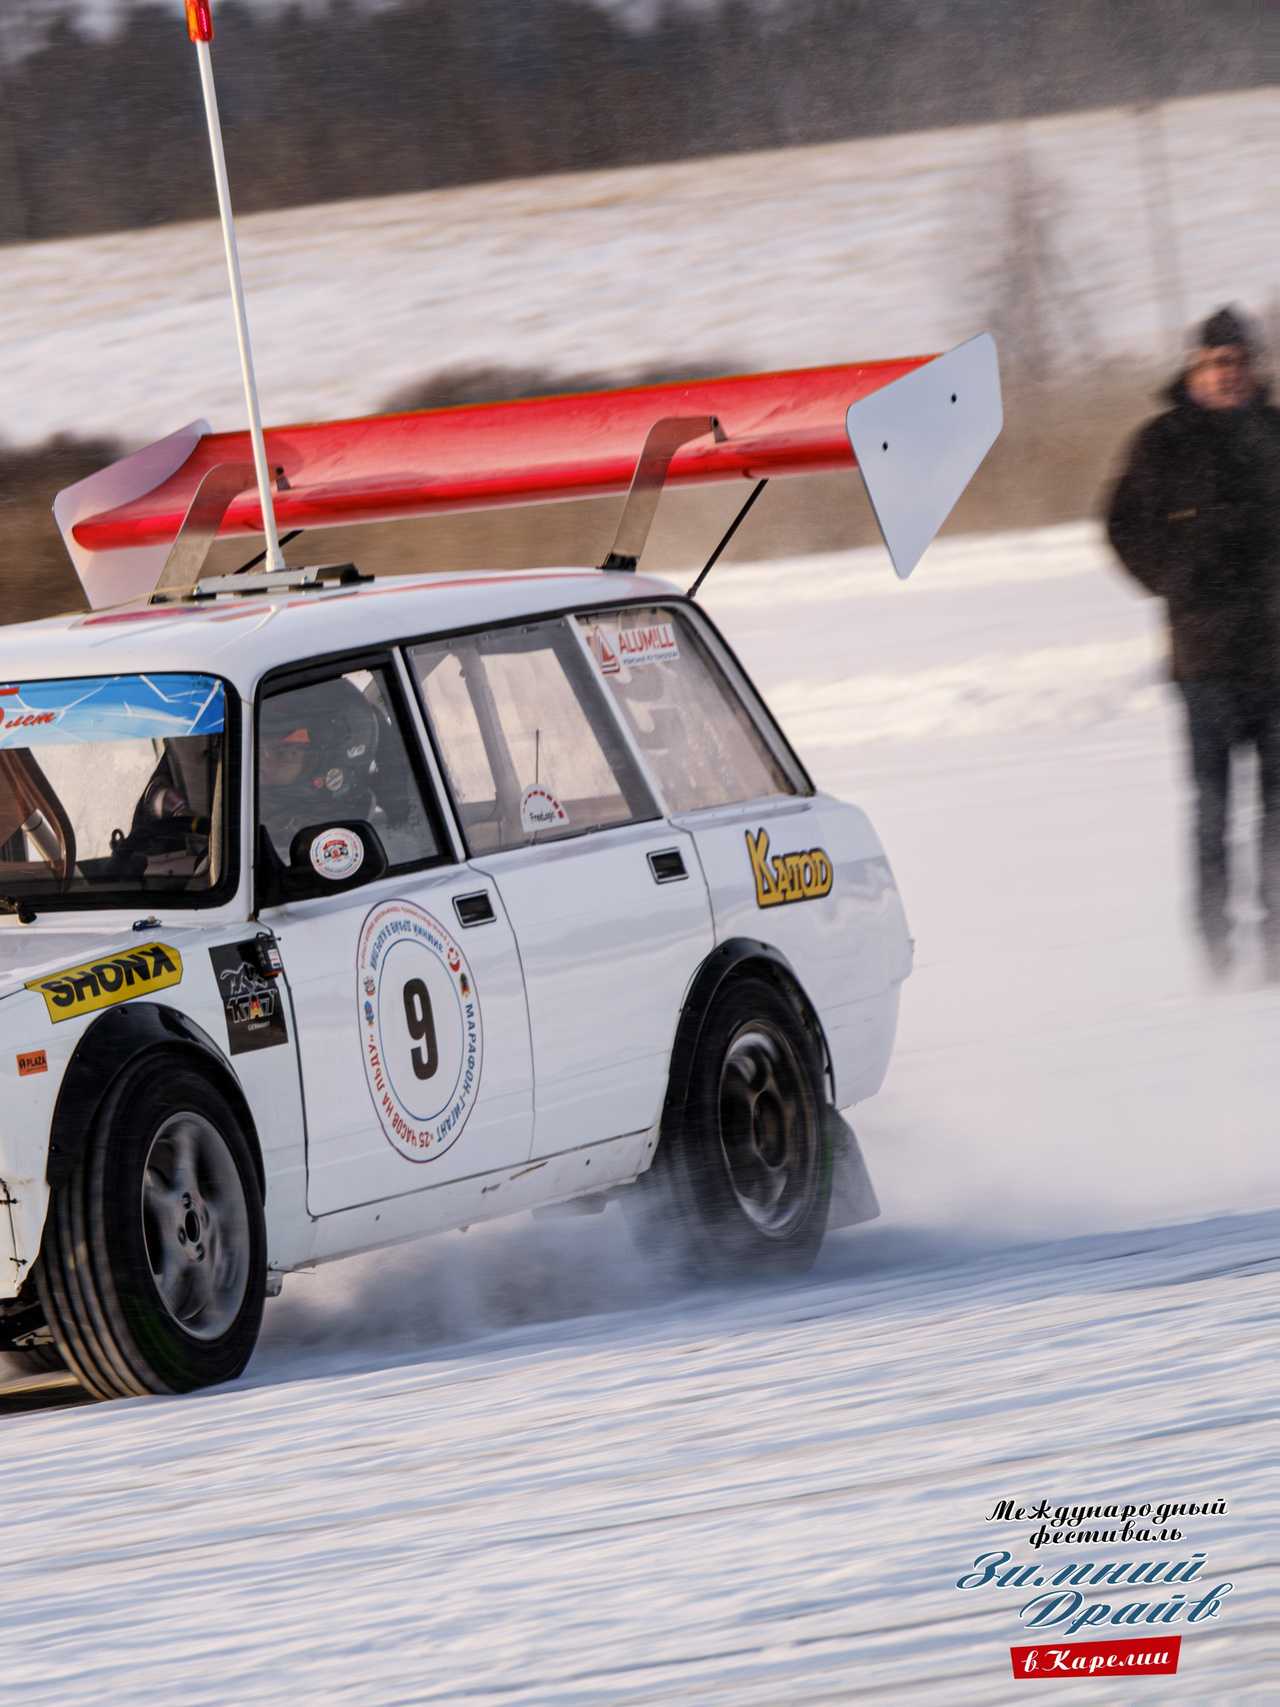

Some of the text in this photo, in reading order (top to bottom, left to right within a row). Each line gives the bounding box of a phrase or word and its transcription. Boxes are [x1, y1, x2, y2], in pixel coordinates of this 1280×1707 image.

[5, 711, 57, 730] лет
[41, 946, 178, 1008] SHONX
[403, 977, 439, 1081] 9
[381, 1091, 394, 1118] НА
[392, 1112, 418, 1147] ЧАСОВ
